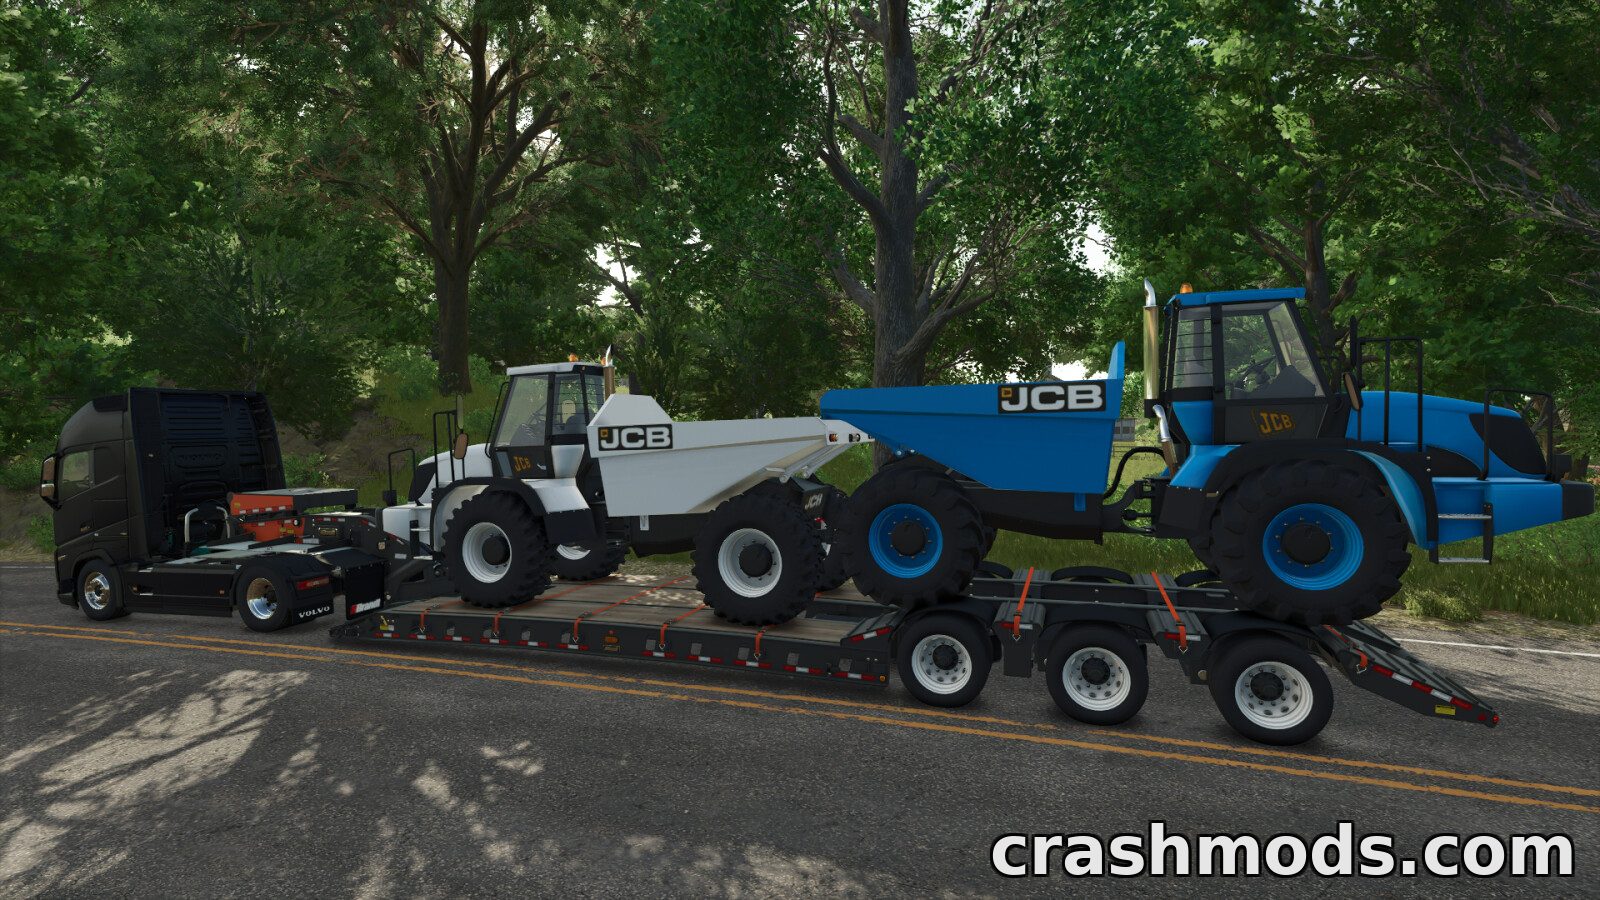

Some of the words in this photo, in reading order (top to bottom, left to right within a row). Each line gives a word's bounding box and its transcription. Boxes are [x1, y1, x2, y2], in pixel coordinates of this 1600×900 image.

[1001, 385, 1103, 412] JCB
[1259, 412, 1293, 434] JCB
[600, 427, 671, 449] JCB
[298, 606, 330, 618] VOLVO
